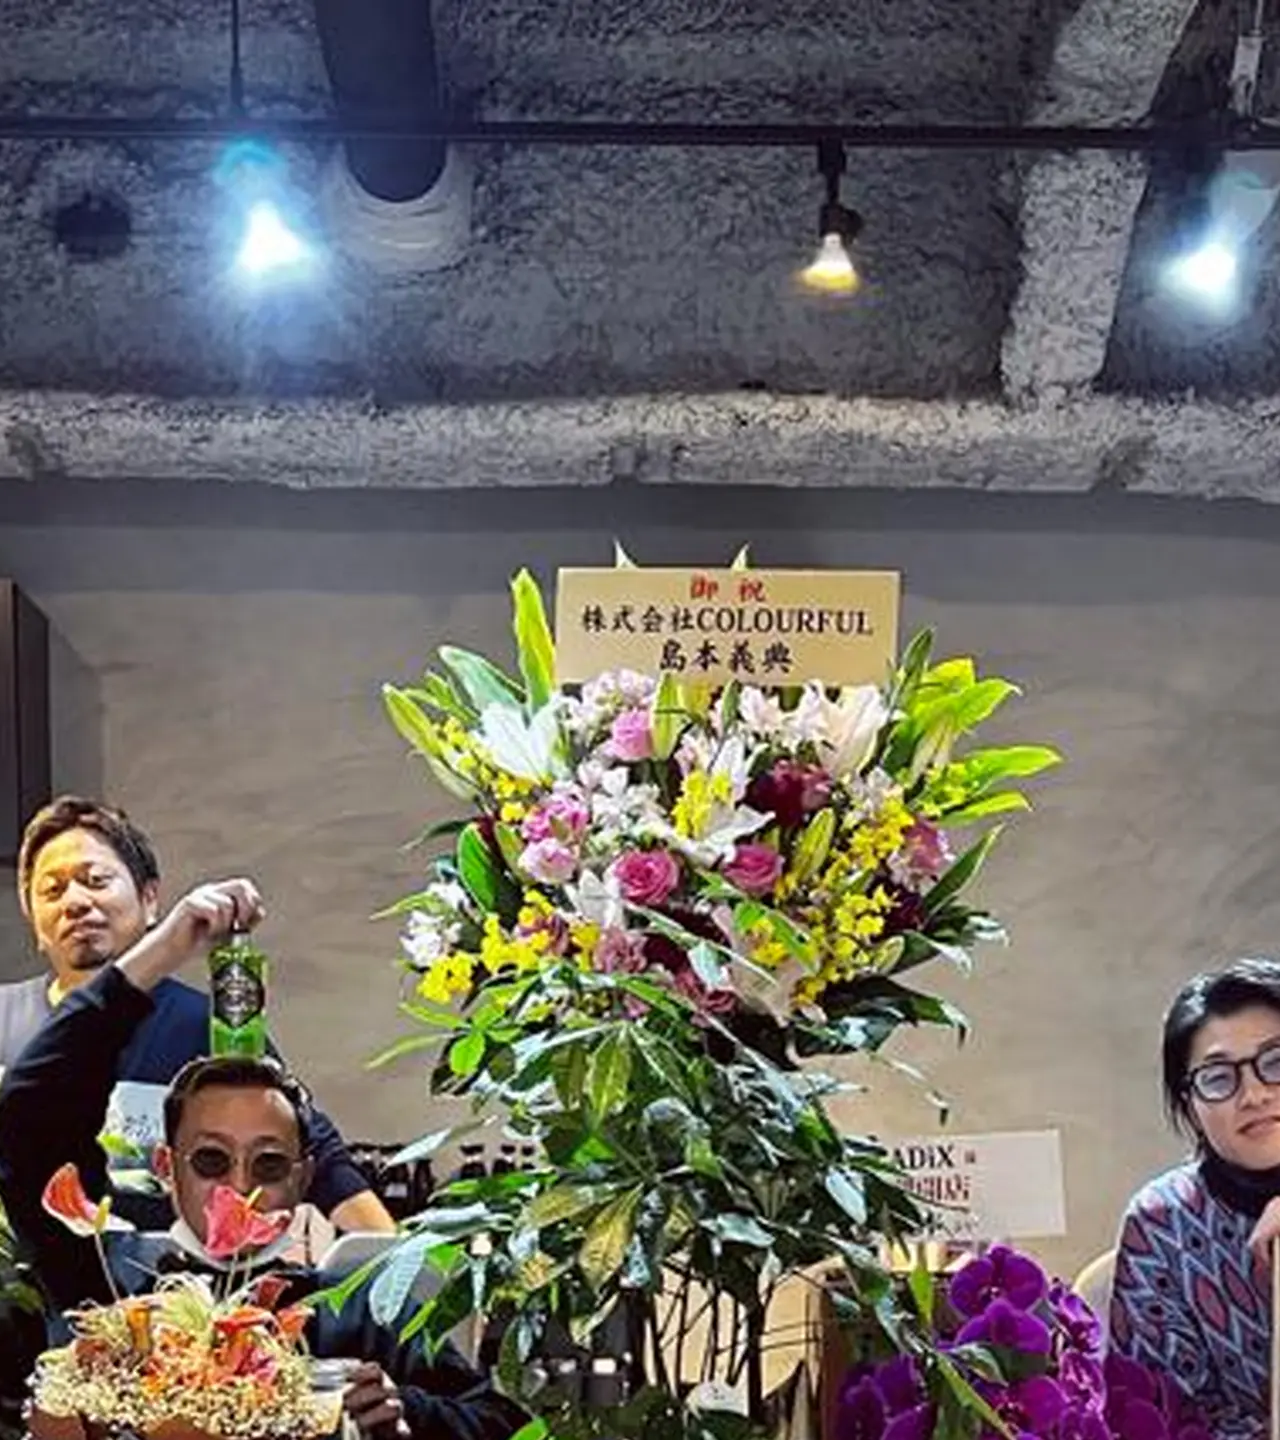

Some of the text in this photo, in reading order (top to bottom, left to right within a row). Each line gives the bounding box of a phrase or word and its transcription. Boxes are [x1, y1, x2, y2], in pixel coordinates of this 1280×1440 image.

[582, 604, 874, 635] 株式会社COLOURFUL
[659, 639, 793, 674] 島本義典
[891, 1145, 955, 1170] ADiX
